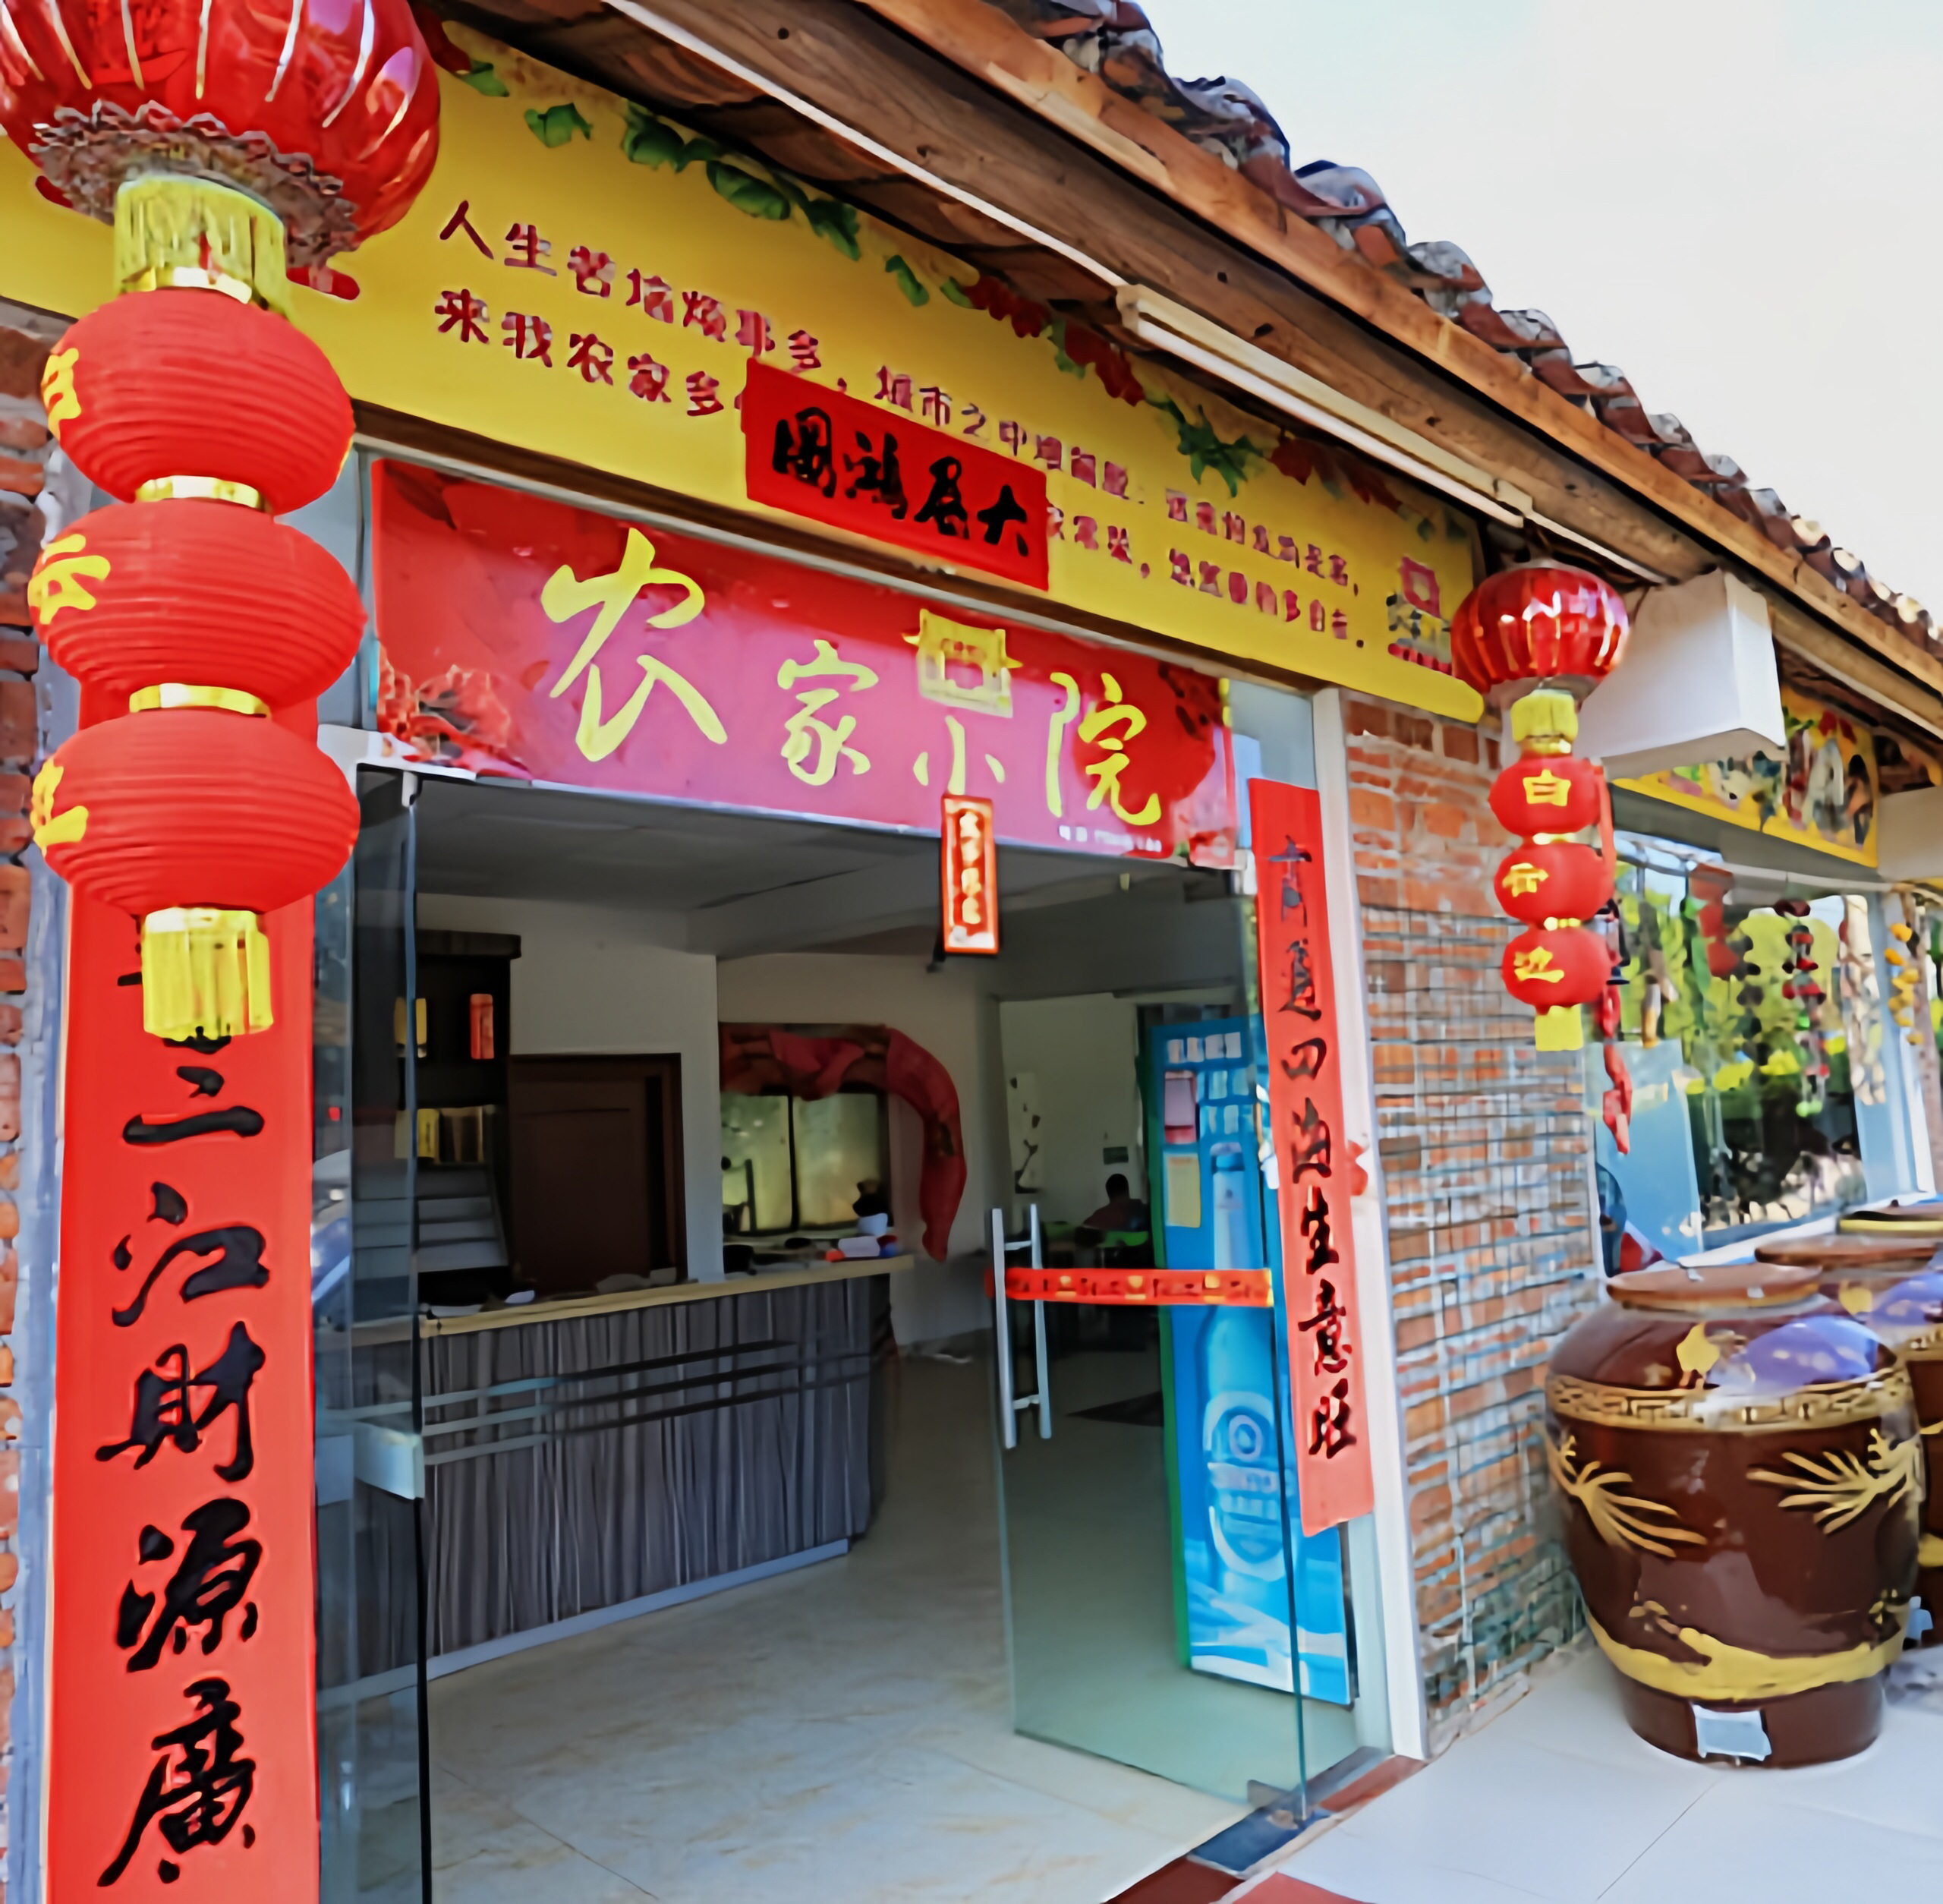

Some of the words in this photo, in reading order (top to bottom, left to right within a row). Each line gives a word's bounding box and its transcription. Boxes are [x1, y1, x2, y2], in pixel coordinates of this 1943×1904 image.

[434, 288, 744, 417] 来我农家多
[540, 527, 1162, 826] 农家小院
